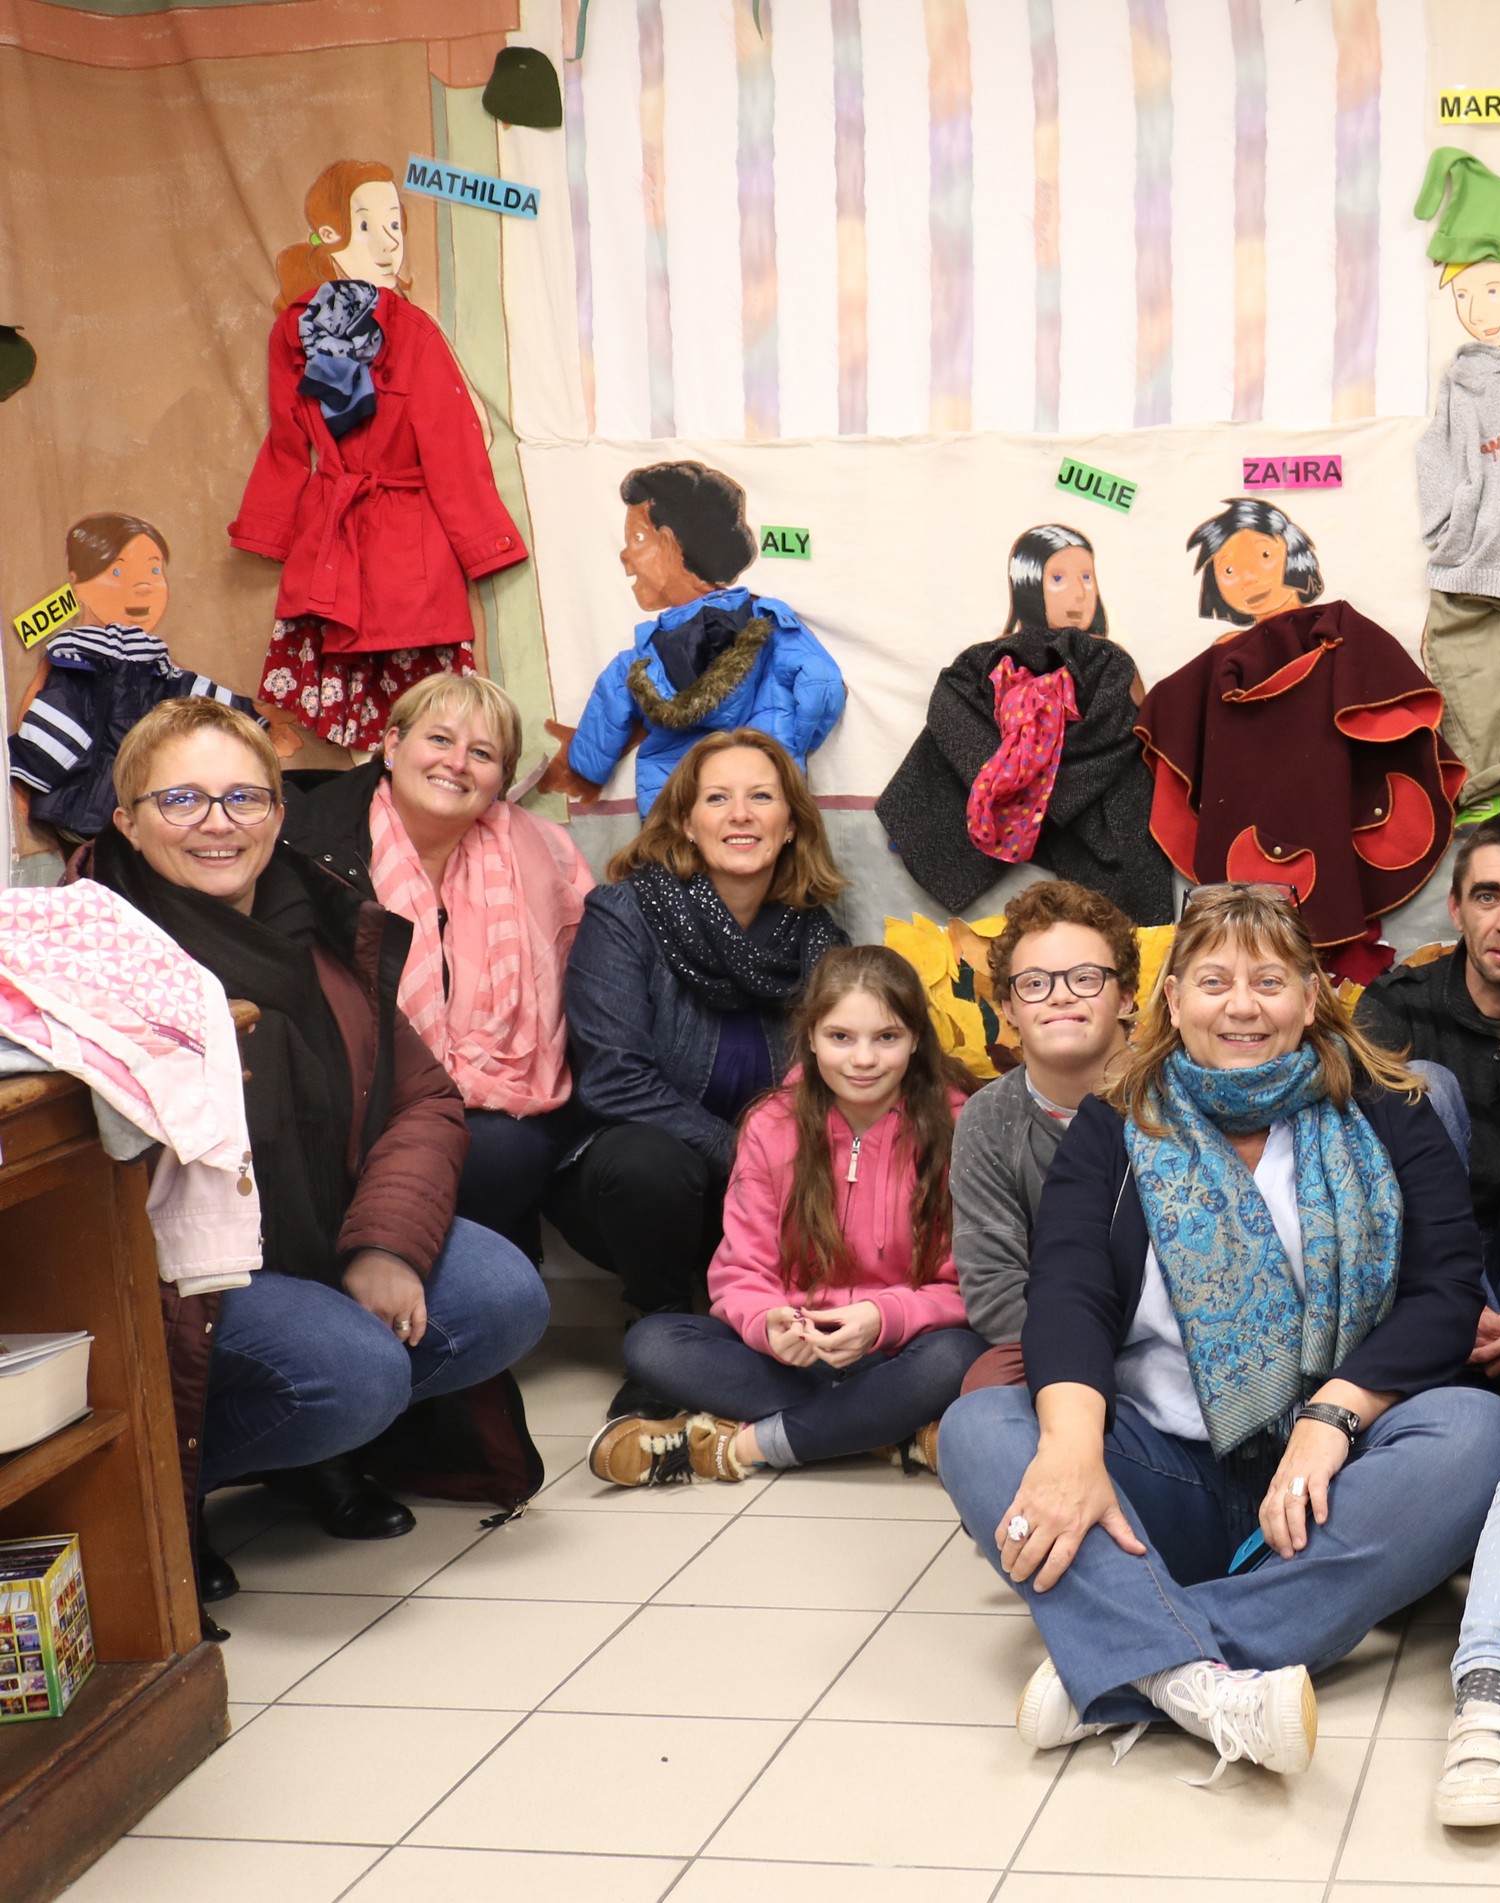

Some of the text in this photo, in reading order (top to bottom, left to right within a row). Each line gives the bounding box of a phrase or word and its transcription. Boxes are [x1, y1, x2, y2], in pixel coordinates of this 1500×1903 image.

[406, 163, 538, 215] MATHILDA
[1057, 465, 1136, 509] JULIE
[1243, 460, 1343, 484] ZAHRA
[761, 531, 810, 553] ALY
[20, 589, 77, 643] ADEM
